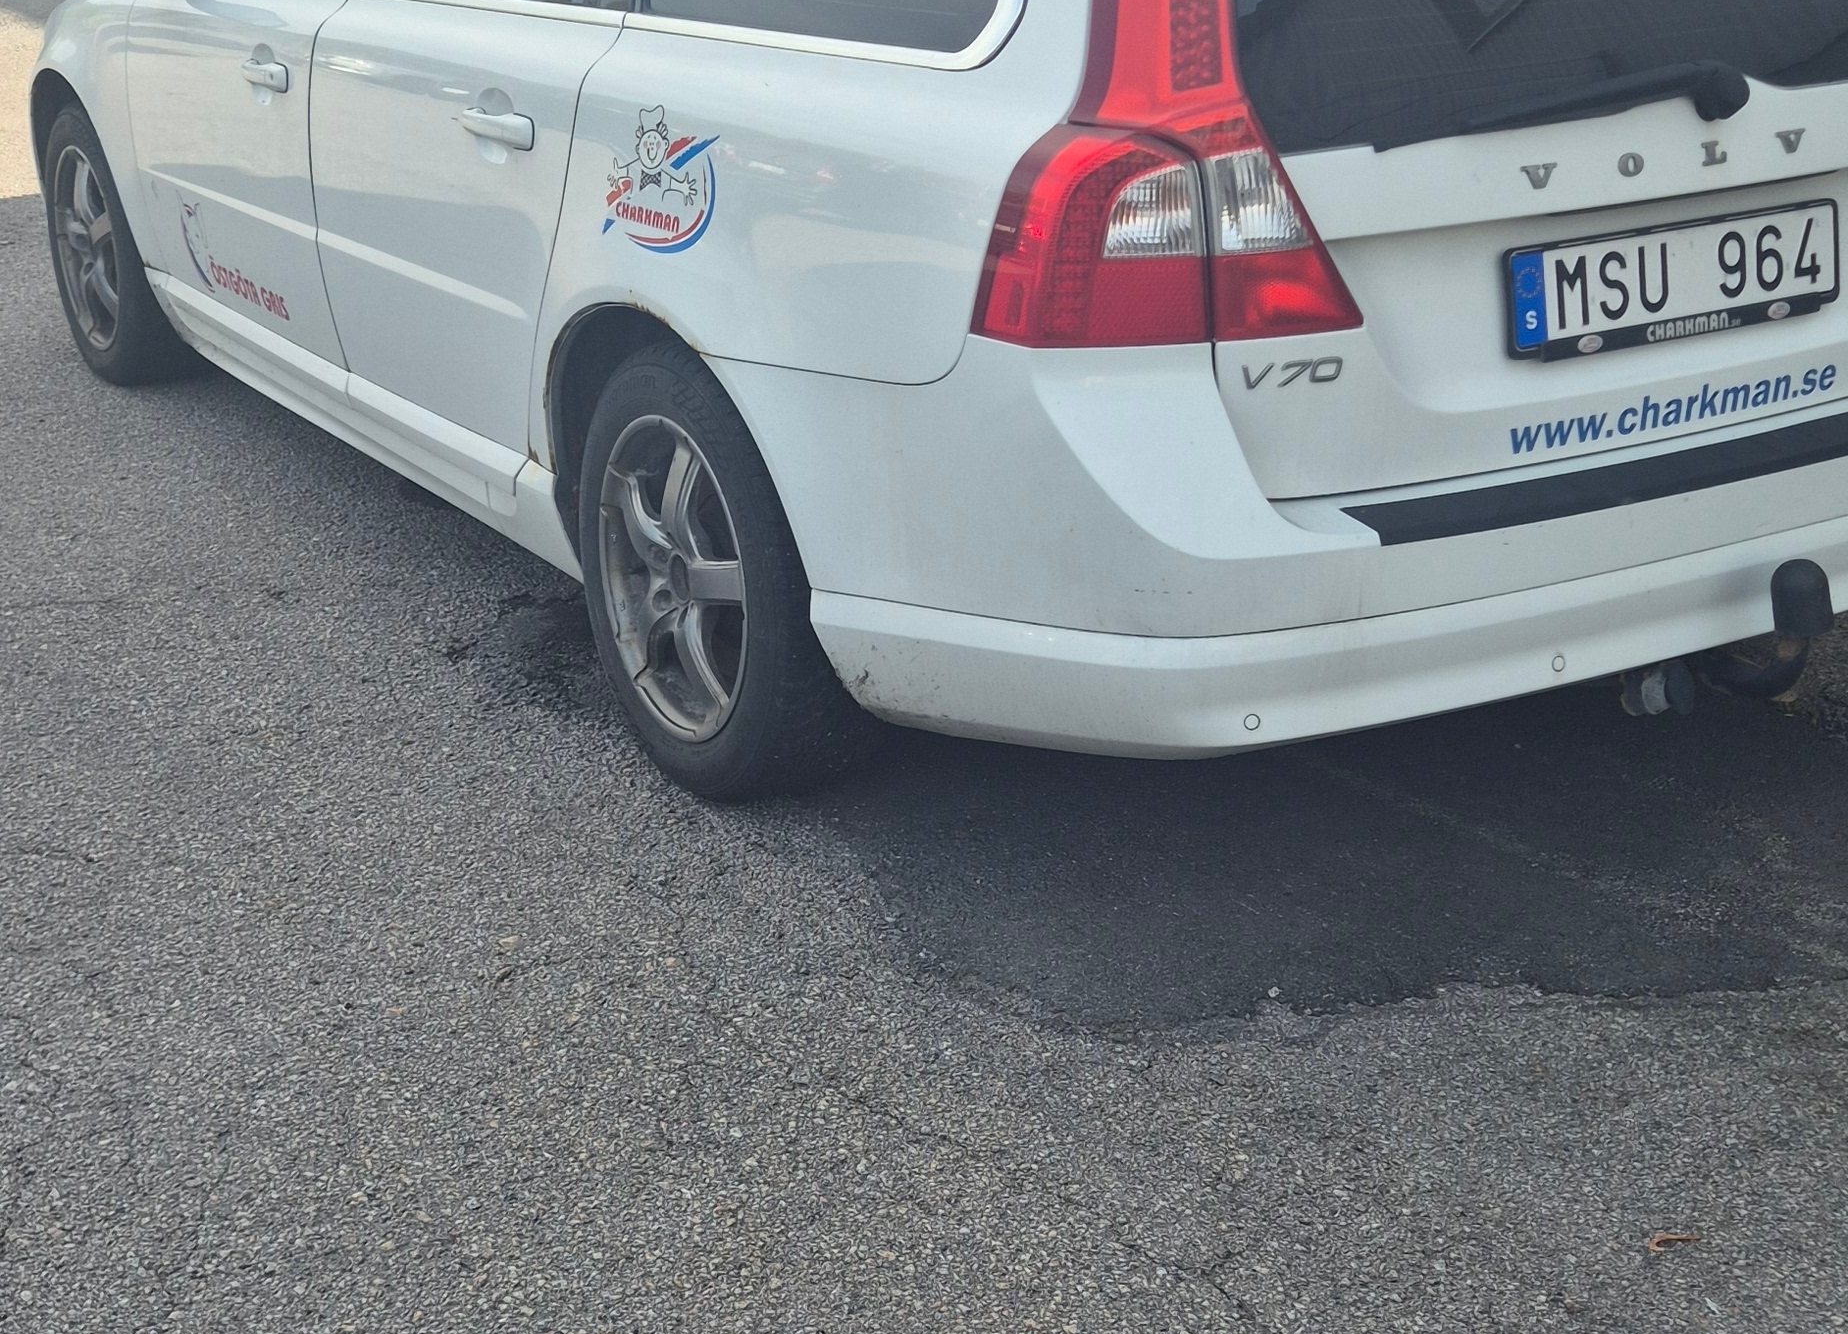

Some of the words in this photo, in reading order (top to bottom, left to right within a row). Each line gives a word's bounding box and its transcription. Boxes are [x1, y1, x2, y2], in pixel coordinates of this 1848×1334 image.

[615, 200, 680, 234] CHARKMAN
[208, 254, 262, 307] ÖSTGÖTA
[260, 286, 290, 321] GRIS
[1554, 242, 1669, 331] MSU
[1717, 217, 1822, 299] 964
[1525, 310, 1538, 330] S
[1241, 355, 1344, 390] V70
[1509, 364, 1838, 455] www.charkman.se
